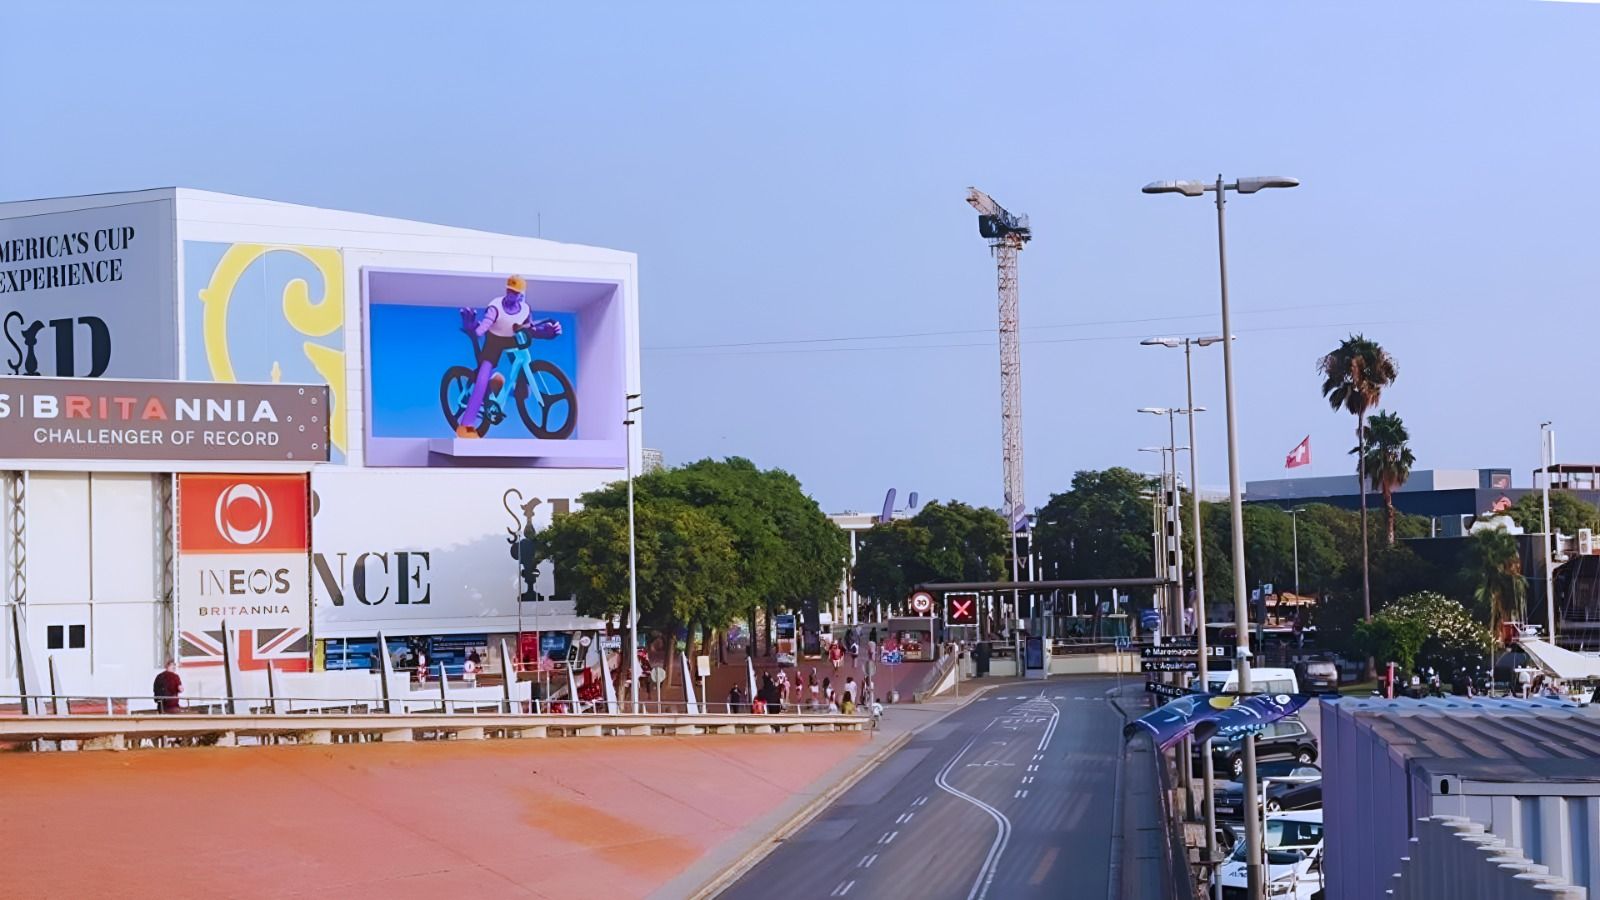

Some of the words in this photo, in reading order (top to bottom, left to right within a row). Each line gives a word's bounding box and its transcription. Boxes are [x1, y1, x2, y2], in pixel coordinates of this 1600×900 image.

[94, 226, 135, 253] CUP
[0, 258, 123, 293] EXPERIENCE
[33, 394, 279, 423] BRITANNIA
[33, 428, 163, 446] CHALLENGER
[170, 430, 195, 445] OF
[203, 431, 279, 446] RECORD
[199, 568, 290, 596] INEOS
[199, 605, 290, 616] BRITANNIA
[917, 599, 927, 608] 30
